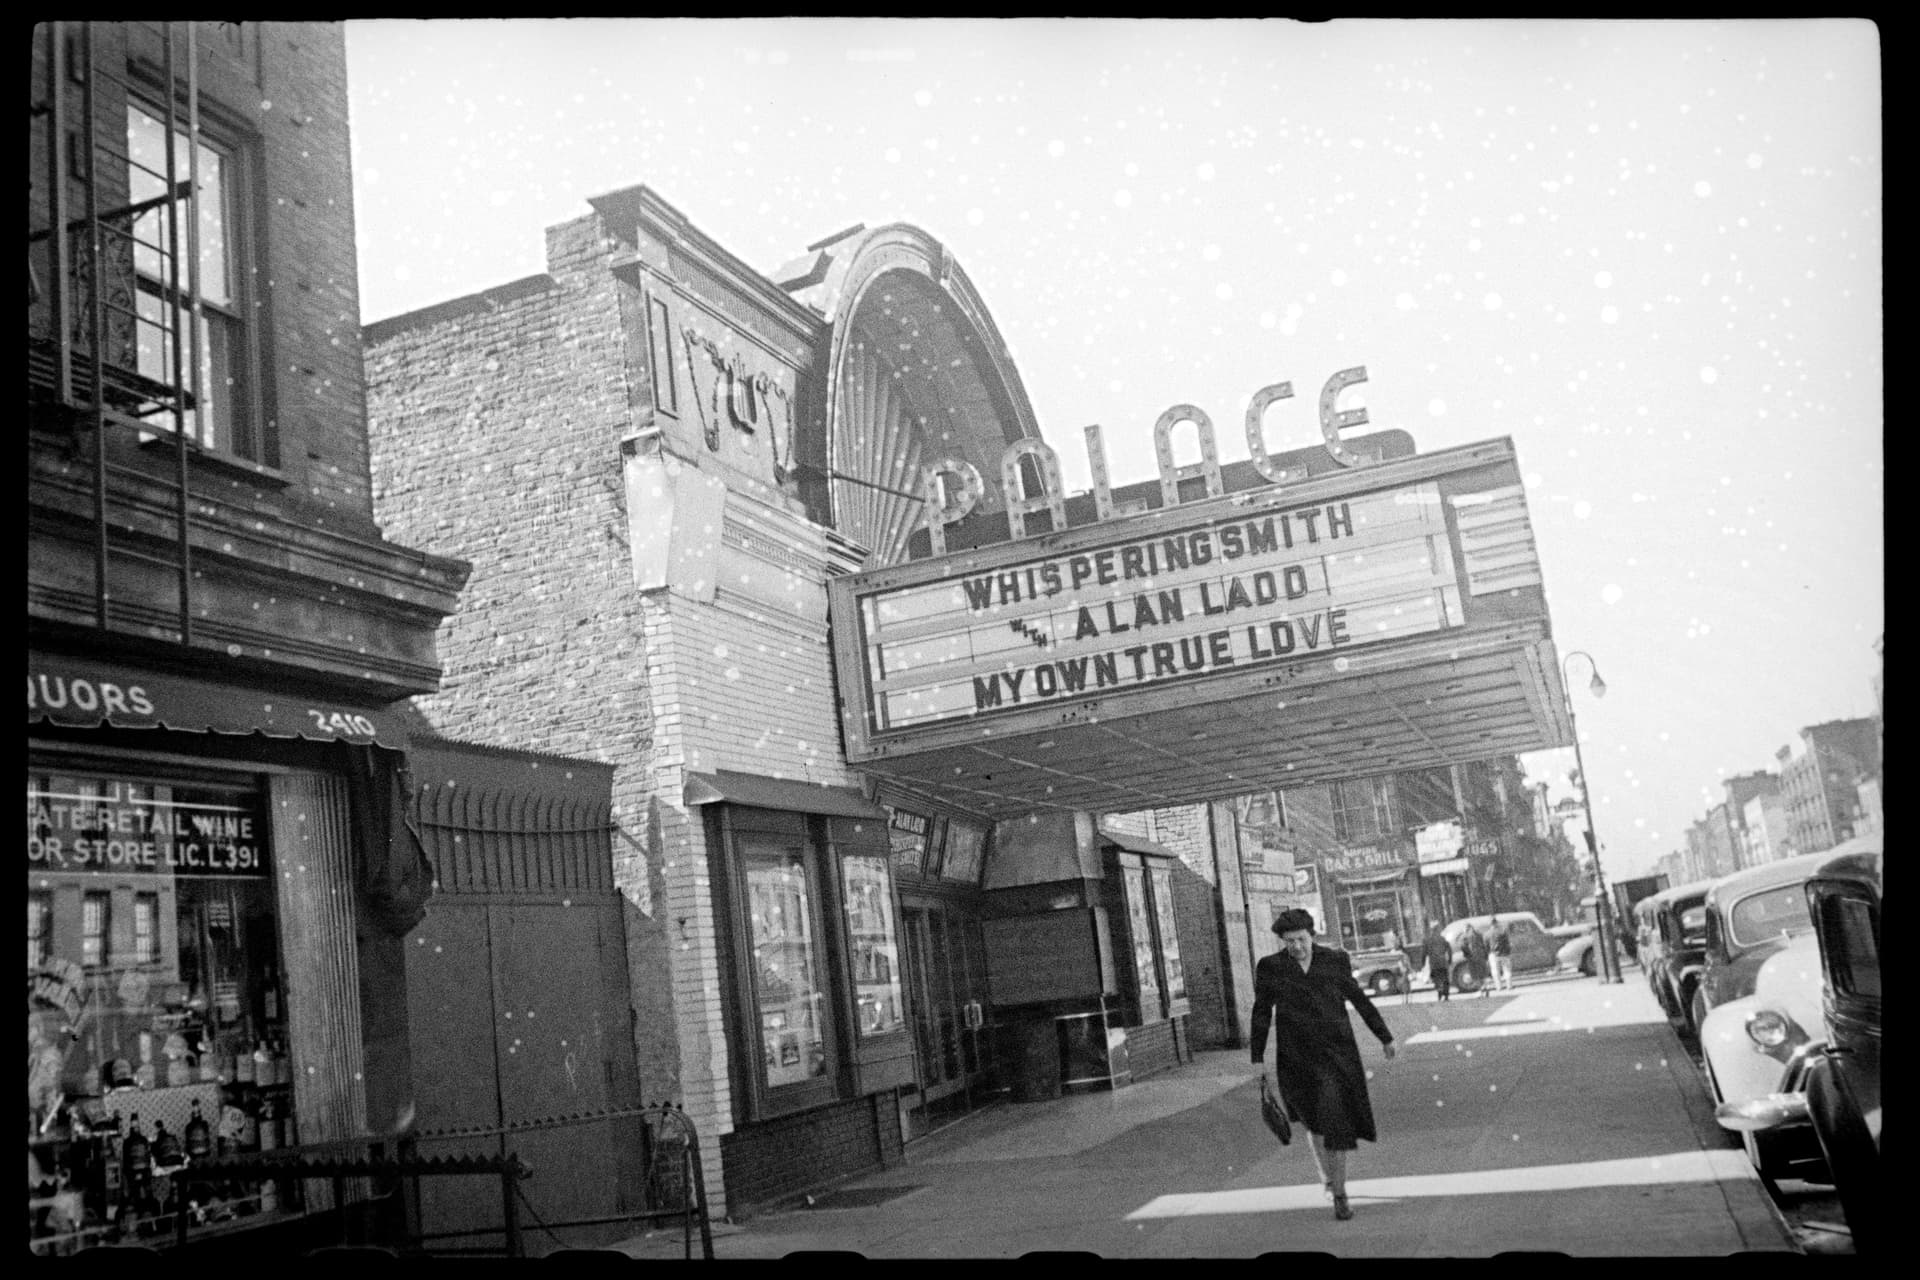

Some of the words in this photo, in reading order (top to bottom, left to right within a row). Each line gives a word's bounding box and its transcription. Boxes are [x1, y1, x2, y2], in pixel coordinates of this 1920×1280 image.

[923, 366, 1382, 556] PALACE
[963, 530, 1213, 610] WHISPERING
[1221, 503, 1353, 559] SMITH
[1009, 618, 1048, 648] WITH
[1076, 588, 1184, 640] ALAN
[1200, 565, 1308, 616] LADD
[973, 669, 1025, 709] MY
[1035, 652, 1119, 697] OWN
[1125, 630, 1234, 681] TRUE
[28, 674, 154, 716] UORS
[308, 710, 376, 736] 2410
[32, 805, 86, 830] ATE
[98, 808, 190, 836] RETAIL
[193, 814, 254, 840] WINE
[73, 838, 157, 866] STORE
[1325, 857, 1351, 873] BAR
[1365, 849, 1402, 866] GRILL
